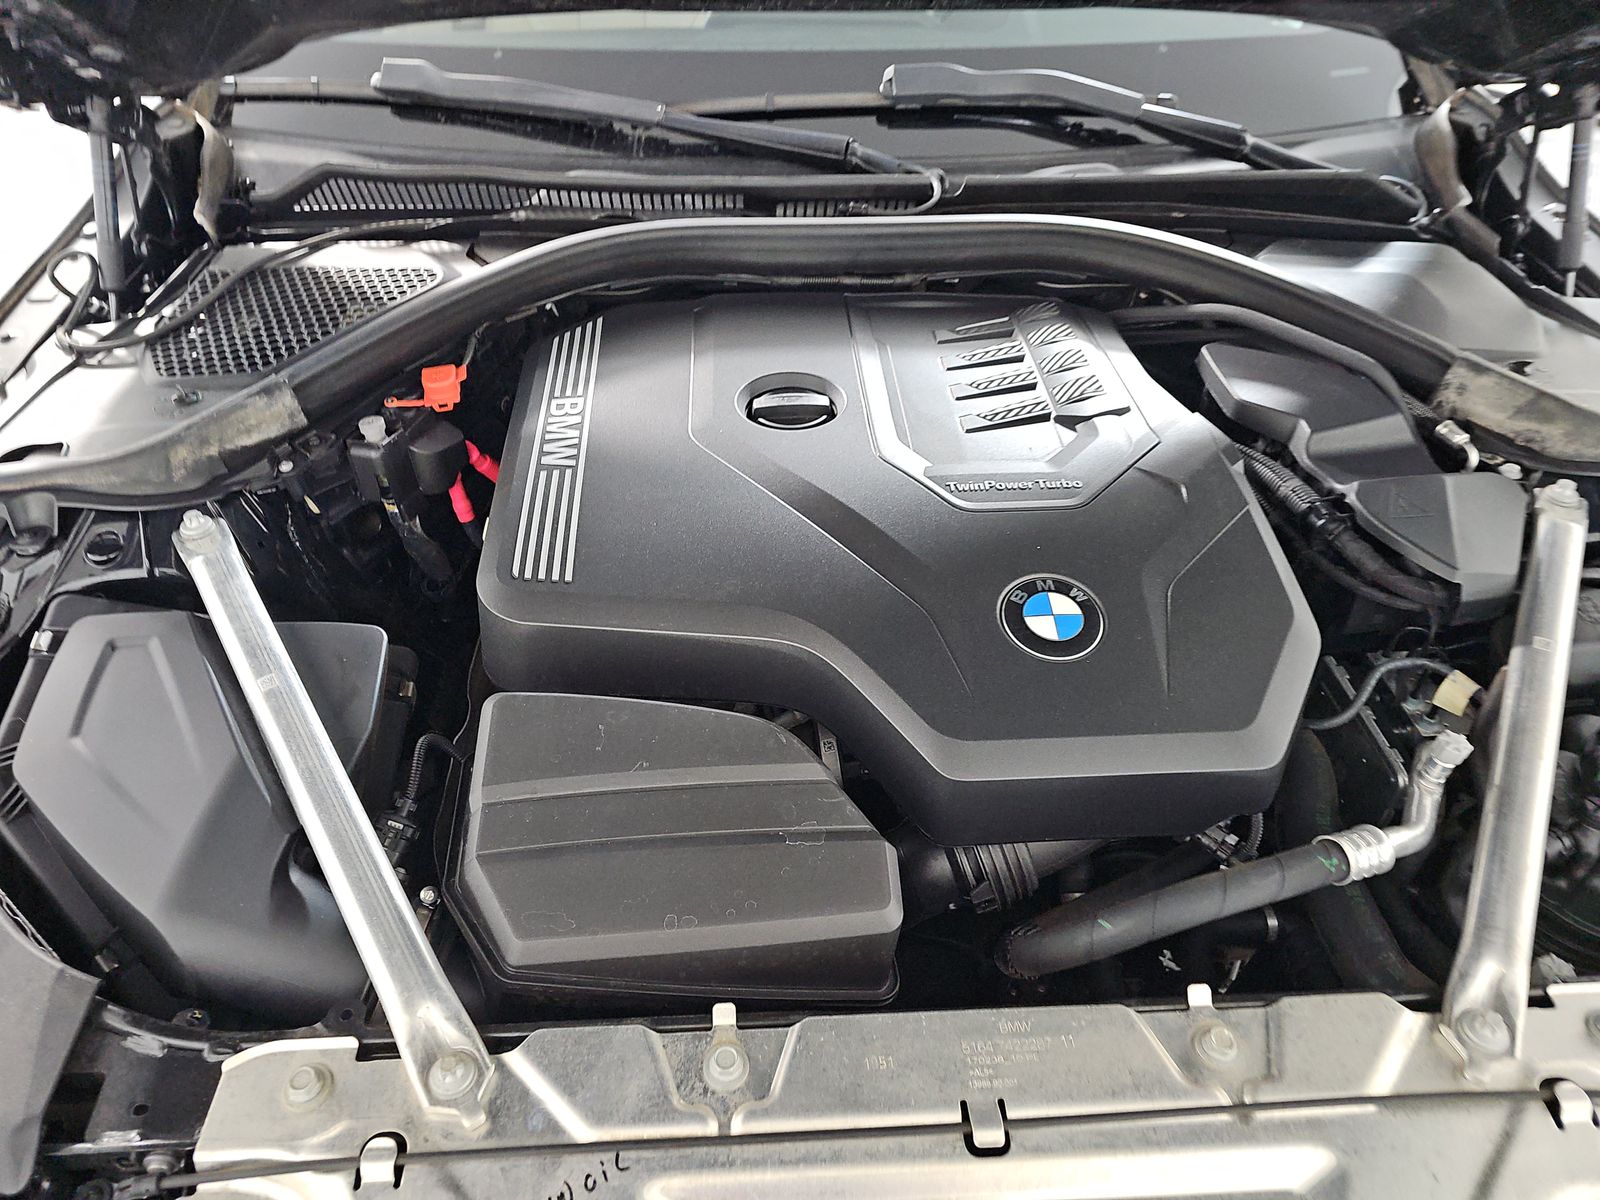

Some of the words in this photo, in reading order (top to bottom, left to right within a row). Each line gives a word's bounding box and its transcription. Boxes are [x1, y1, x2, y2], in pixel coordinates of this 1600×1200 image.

[541, 397, 585, 467] BMW
[945, 480, 1033, 493] TwinPower
[1034, 478, 1084, 491] Turbo
[1009, 579, 1089, 605] BMW
[999, 1020, 1031, 1033] BMW
[1060, 1033, 1076, 1049] 11
